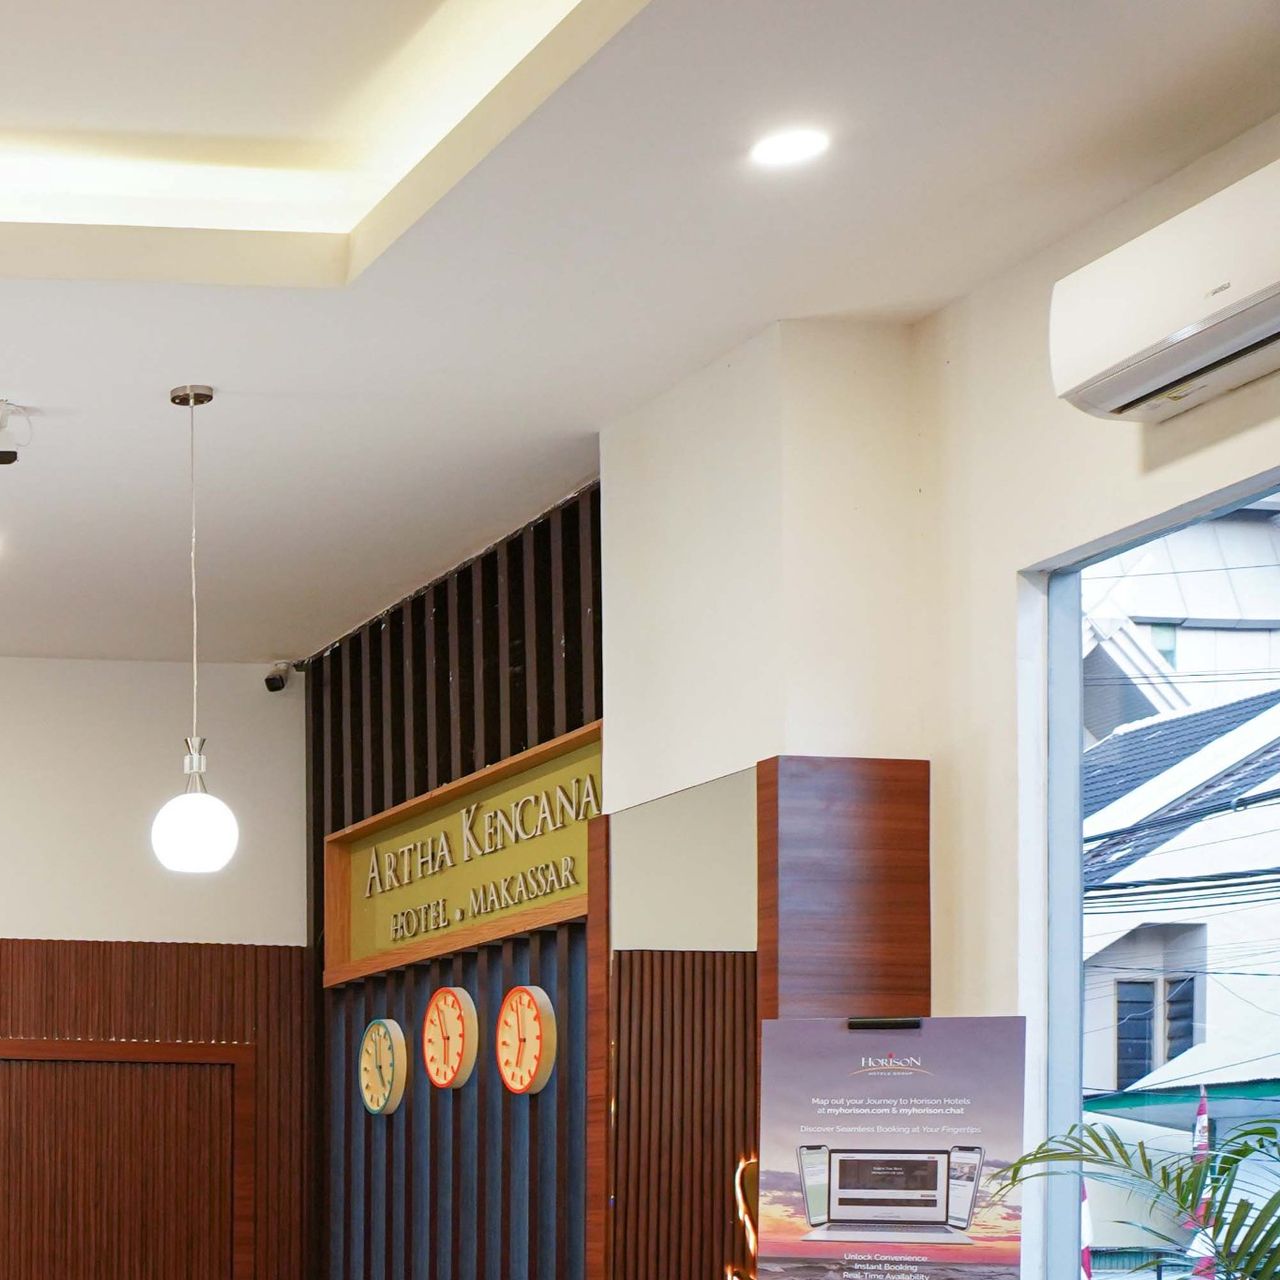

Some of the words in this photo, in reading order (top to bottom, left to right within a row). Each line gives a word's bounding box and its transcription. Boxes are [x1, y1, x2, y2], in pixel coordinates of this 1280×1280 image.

[364, 830, 456, 898] ARTHA
[460, 773, 601, 862] KENCANA
[391, 898, 449, 941] HOTEL
[468, 855, 579, 917] MAKASSAR
[811, 1097, 830, 1106] Map
[845, 1098, 864, 1107] your
[865, 1097, 898, 1107] Journey
[910, 1097, 942, 1105] Horison
[943, 1097, 971, 1105] Hotels
[827, 1106, 890, 1116] myhorison.com
[899, 1106, 965, 1116] myhorison.chat
[876, 1125, 911, 1135] Booking
[843, 1253, 872, 1261] Unlock
[874, 1253, 928, 1262] Convenience
[884, 1263, 918, 1273] Booking
[842, 1271, 884, 1280] Real-Time
